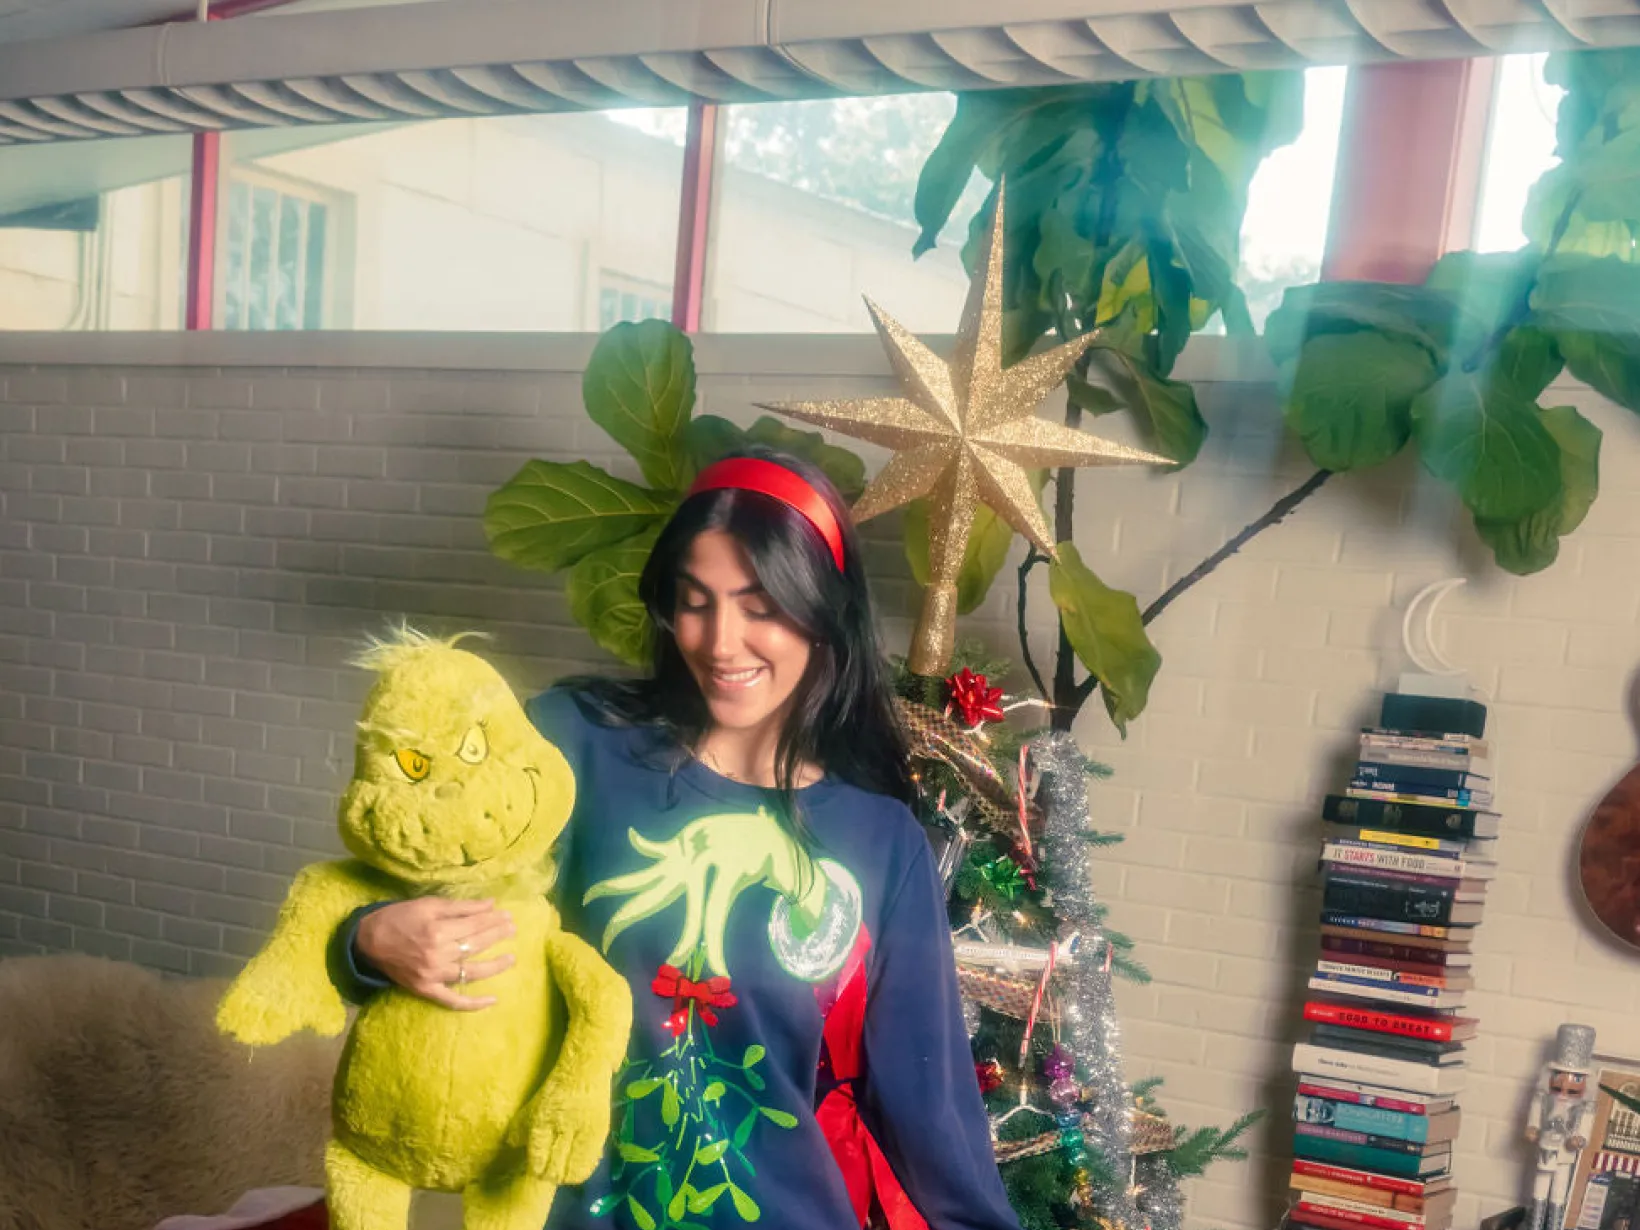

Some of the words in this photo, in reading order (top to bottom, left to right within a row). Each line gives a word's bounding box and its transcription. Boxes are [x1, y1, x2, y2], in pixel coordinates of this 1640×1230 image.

[1333, 848, 1341, 858] IT
[1344, 848, 1375, 862] STARTS
[1377, 854, 1400, 866] WITH
[1401, 856, 1425, 868] FOOD
[1374, 1017, 1388, 1026] TO
